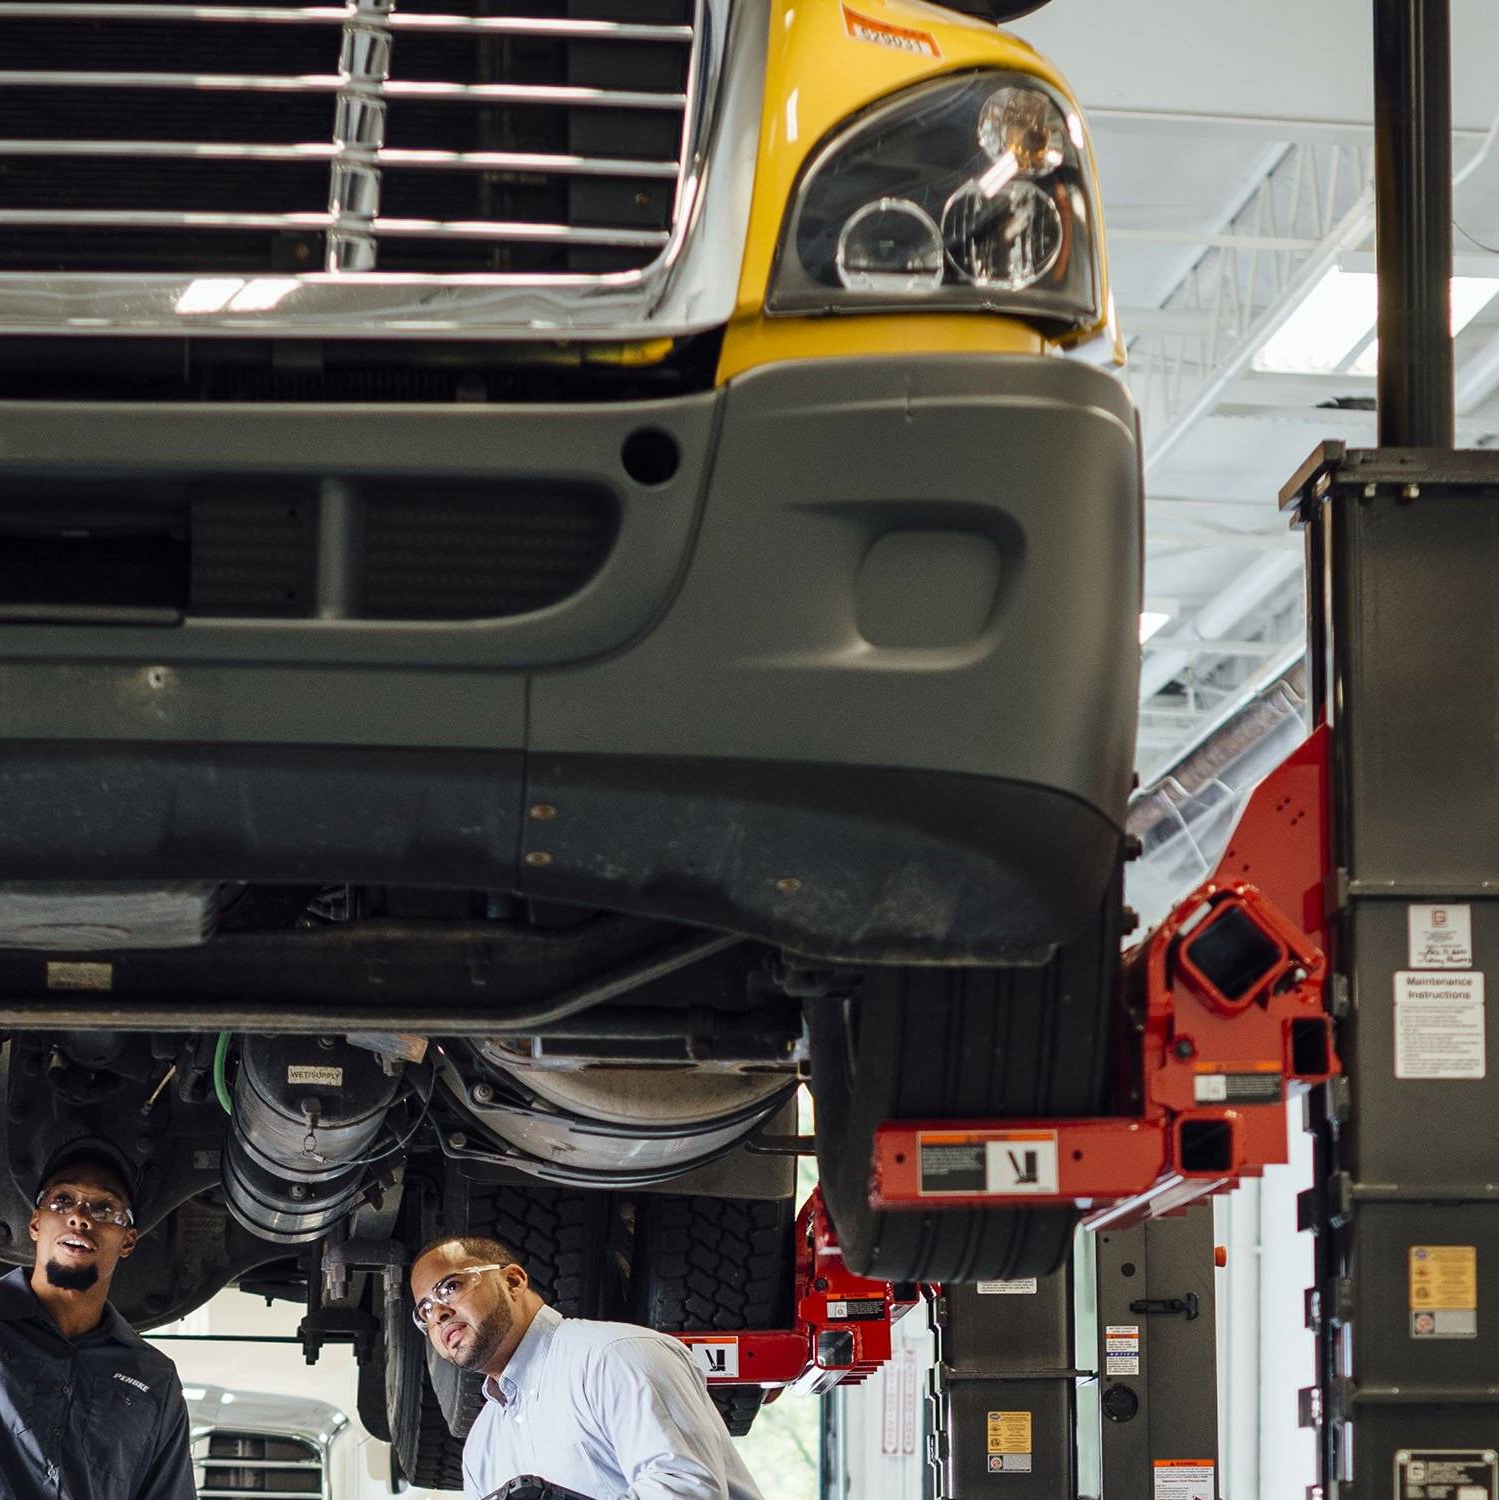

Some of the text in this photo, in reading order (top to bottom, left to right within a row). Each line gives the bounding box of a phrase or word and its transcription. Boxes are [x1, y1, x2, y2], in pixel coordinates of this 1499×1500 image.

[1406, 976, 1472, 986] Maintenance
[1408, 990, 1471, 1000] Instructions
[290, 1070, 340, 1080] WET/SUPPLY
